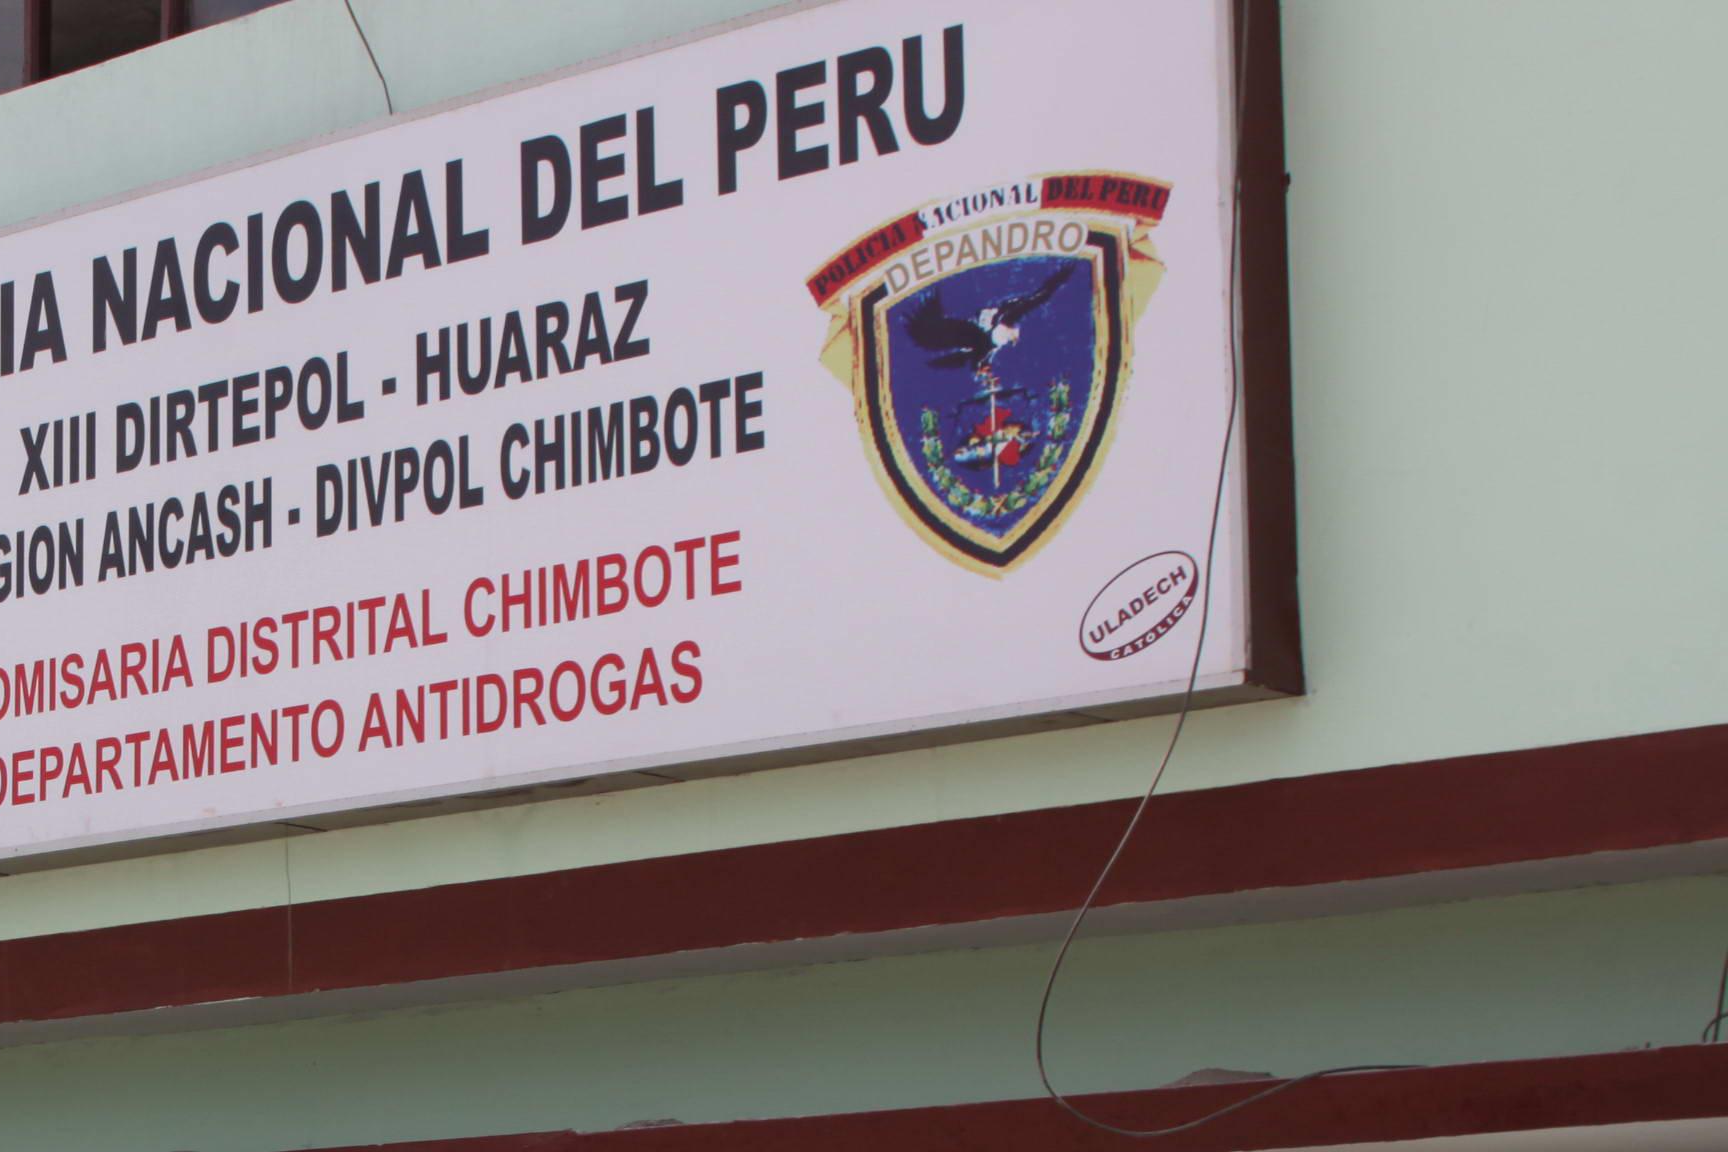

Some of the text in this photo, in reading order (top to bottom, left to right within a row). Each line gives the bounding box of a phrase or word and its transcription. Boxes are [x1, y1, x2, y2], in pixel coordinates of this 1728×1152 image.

[92, 158, 490, 354] NACIONAL
[520, 106, 684, 245] DEL
[716, 23, 966, 196] PERU
[815, 224, 907, 296] POLICIA
[914, 182, 1038, 232] NACIONAL
[1047, 178, 1094, 202] DEL
[884, 218, 1087, 295] DEPANDRO
[18, 411, 96, 496] XIII
[116, 350, 365, 474] DIRTEPOL
[416, 279, 650, 406] HUARAZ
[98, 477, 272, 582] ANCASH
[316, 434, 484, 538] DIVPOL
[500, 371, 765, 500] CHIMBOTE
[207, 588, 448, 684] DISTRITAL
[464, 530, 742, 638] CHIMBOTE
[1088, 565, 1189, 645] ULADECH
[1110, 596, 1195, 661] CATOLICA
[358, 640, 703, 752] ANTIDROGAS
